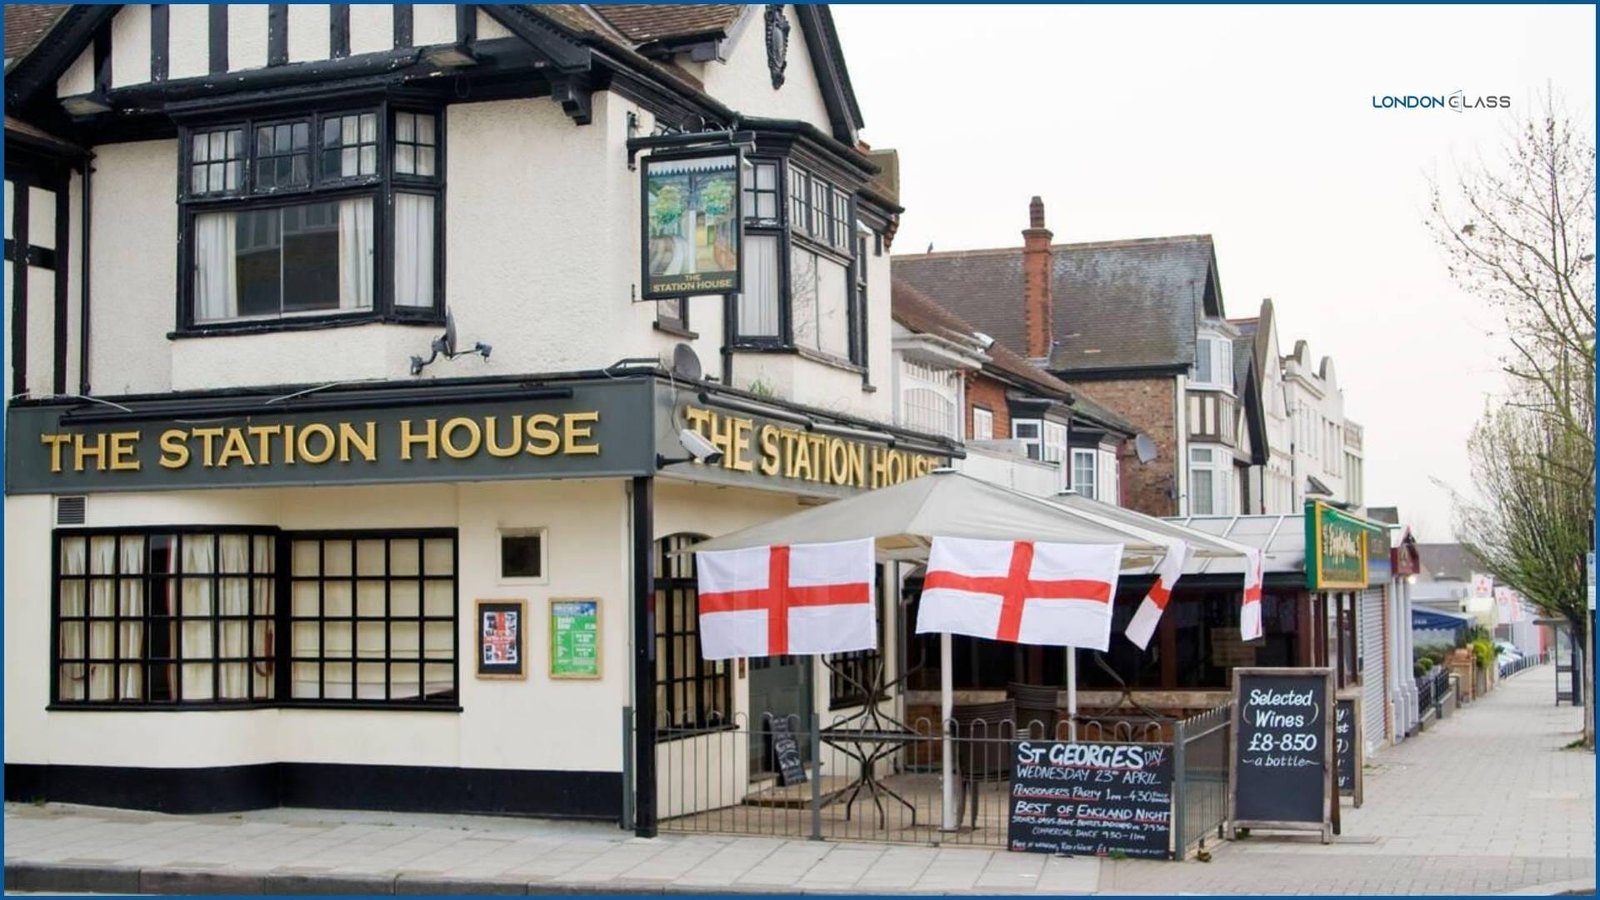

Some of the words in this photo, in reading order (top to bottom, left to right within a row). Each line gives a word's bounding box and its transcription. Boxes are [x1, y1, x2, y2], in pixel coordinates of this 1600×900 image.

[653, 281, 695, 292] STATION
[696, 279, 732, 289] HOUSE
[41, 430, 141, 472] THE
[159, 421, 377, 469] STATION
[400, 411, 599, 459] HOUSE
[687, 406, 754, 472] THE
[760, 424, 866, 488] STATION
[1249, 688, 1313, 706] Selected
[1255, 709, 1305, 728] Wines
[1049, 744, 1144, 769] GEORGES
[1144, 748, 1164, 766] DAY
[1265, 754, 1308, 767] bottle
[1016, 765, 1090, 781] WEDNESDAY
[1122, 771, 1162, 785] APRIL
[1015, 801, 1051, 814] BEST
[1056, 805, 1074, 814] OF
[1076, 804, 1133, 820] ENGLAND
[1135, 809, 1170, 822] NIGHT
